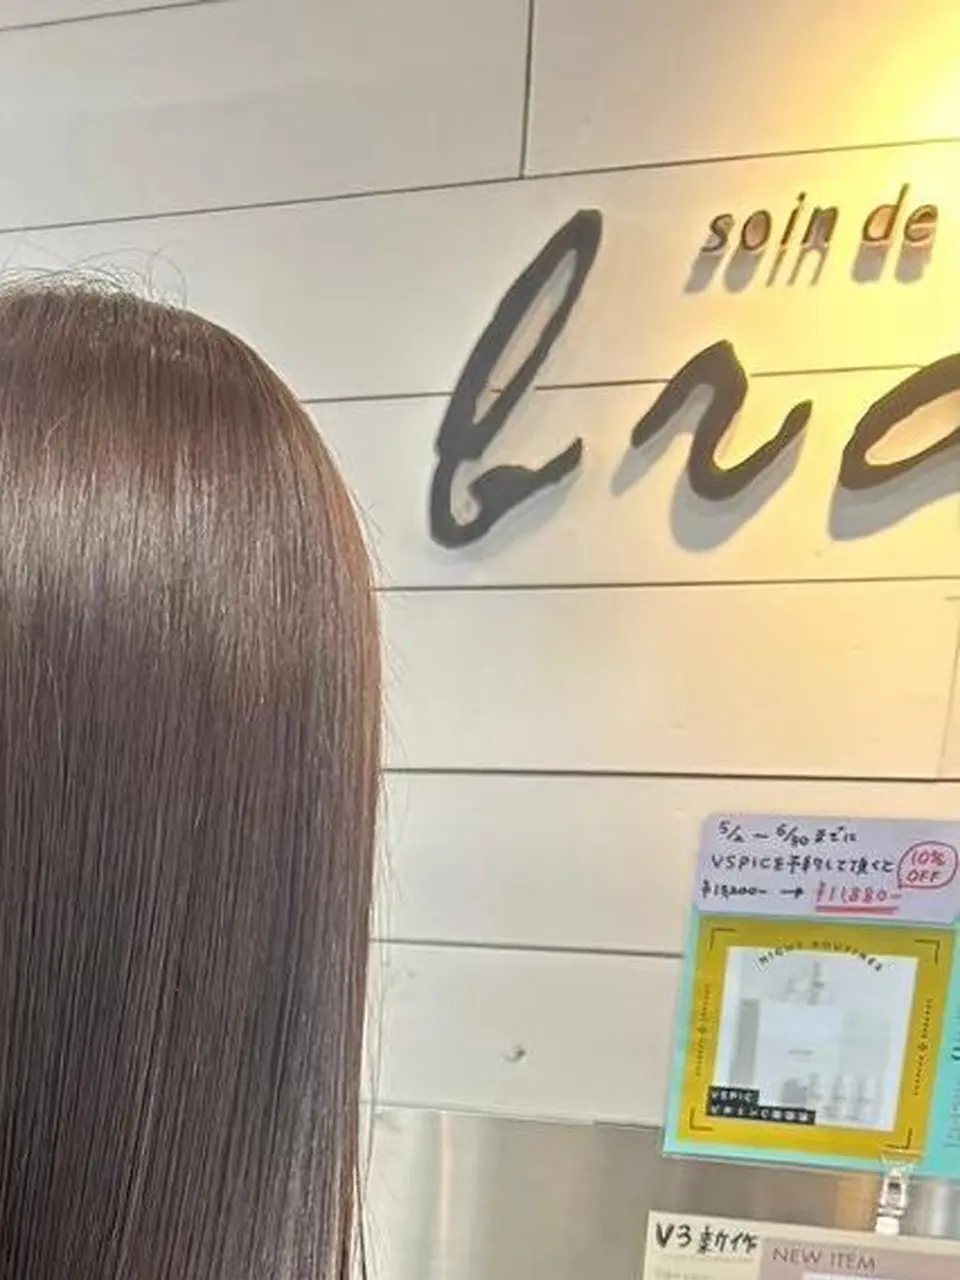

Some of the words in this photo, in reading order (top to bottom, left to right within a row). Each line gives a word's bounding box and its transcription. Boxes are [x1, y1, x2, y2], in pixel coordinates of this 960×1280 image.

[702, 190, 839, 253] soin
[862, 182, 939, 244] de
[911, 849, 946, 867] 10%
[906, 869, 942, 884] OFF
[772, 1247, 822, 1266] NEW
[829, 1251, 877, 1271] ITEM
